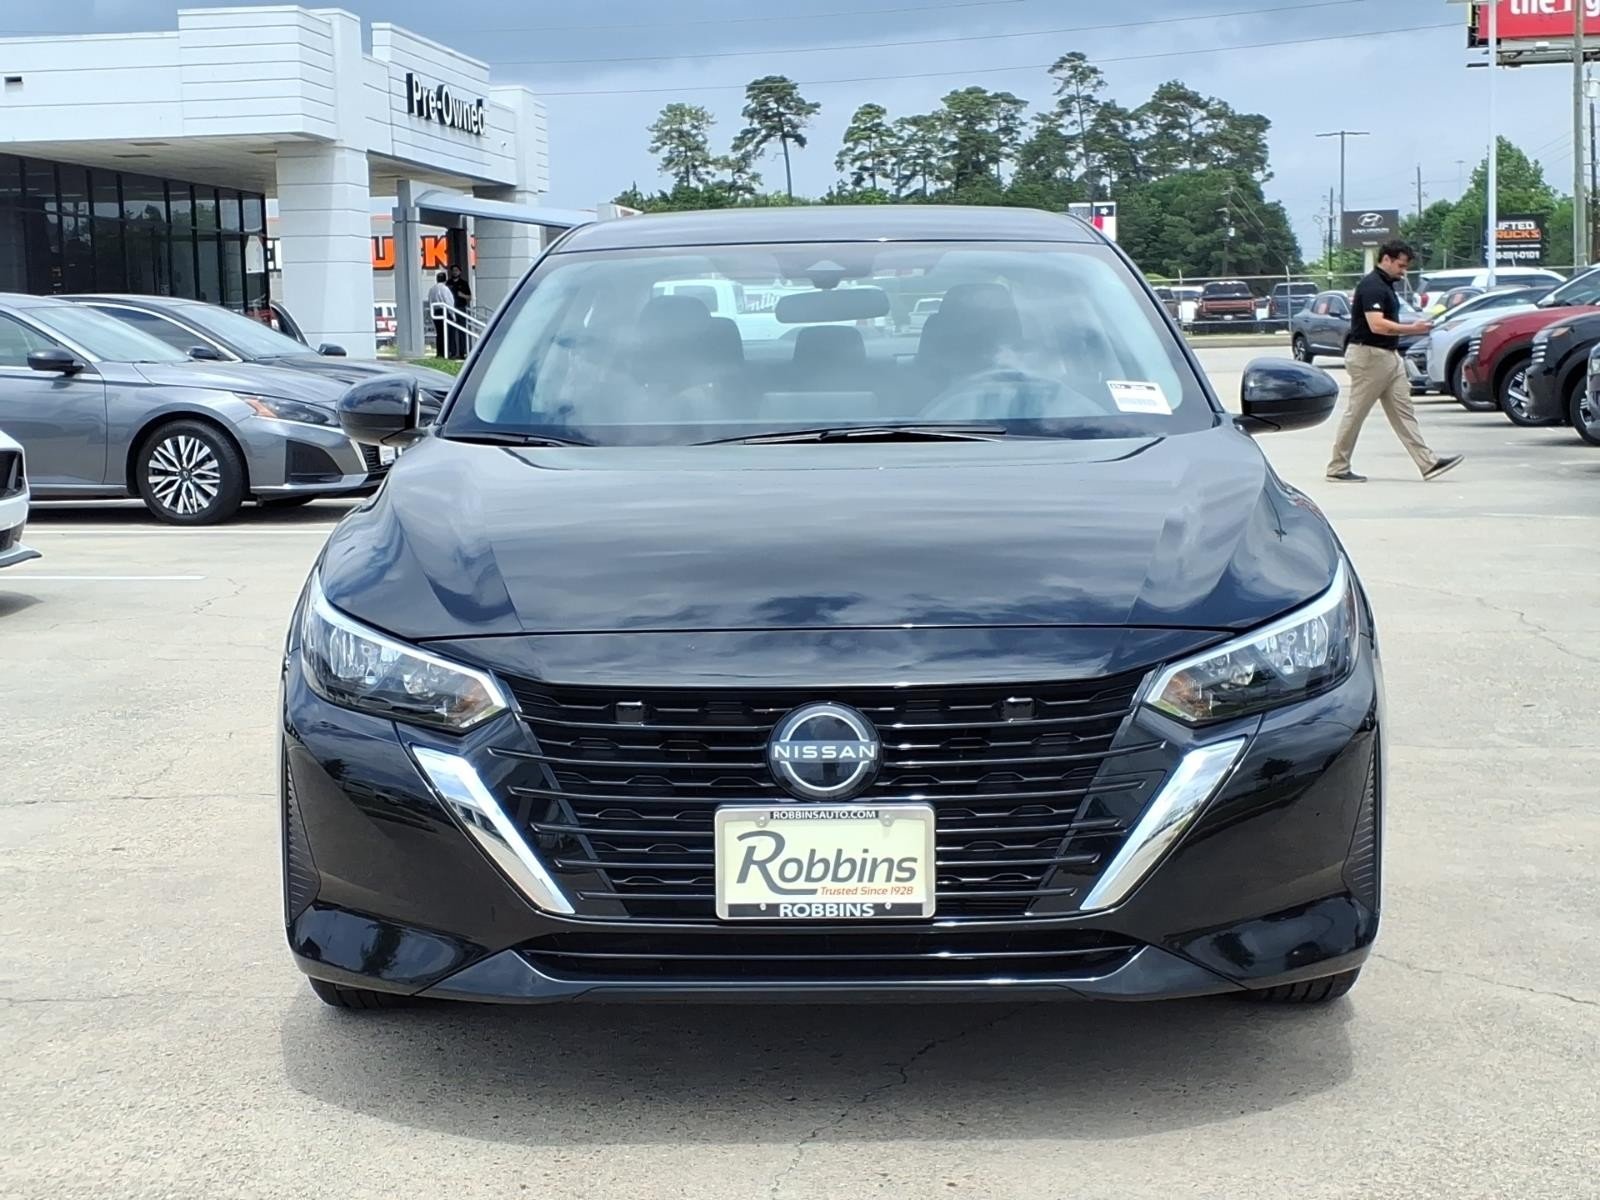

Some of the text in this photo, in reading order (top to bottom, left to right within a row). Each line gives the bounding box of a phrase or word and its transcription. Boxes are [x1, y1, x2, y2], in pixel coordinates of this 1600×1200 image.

[406, 72, 485, 136] Pre-Owned
[1496, 220, 1536, 230] IFTED
[1495, 230, 1541, 240] RUCKS
[774, 744, 875, 759] NISSAN
[773, 810, 877, 820] ROBBINSAUTO.COM
[736, 830, 918, 895] Robbins
[821, 886, 914, 896] Trusted Since 1928
[779, 903, 875, 917] ROBBINS
